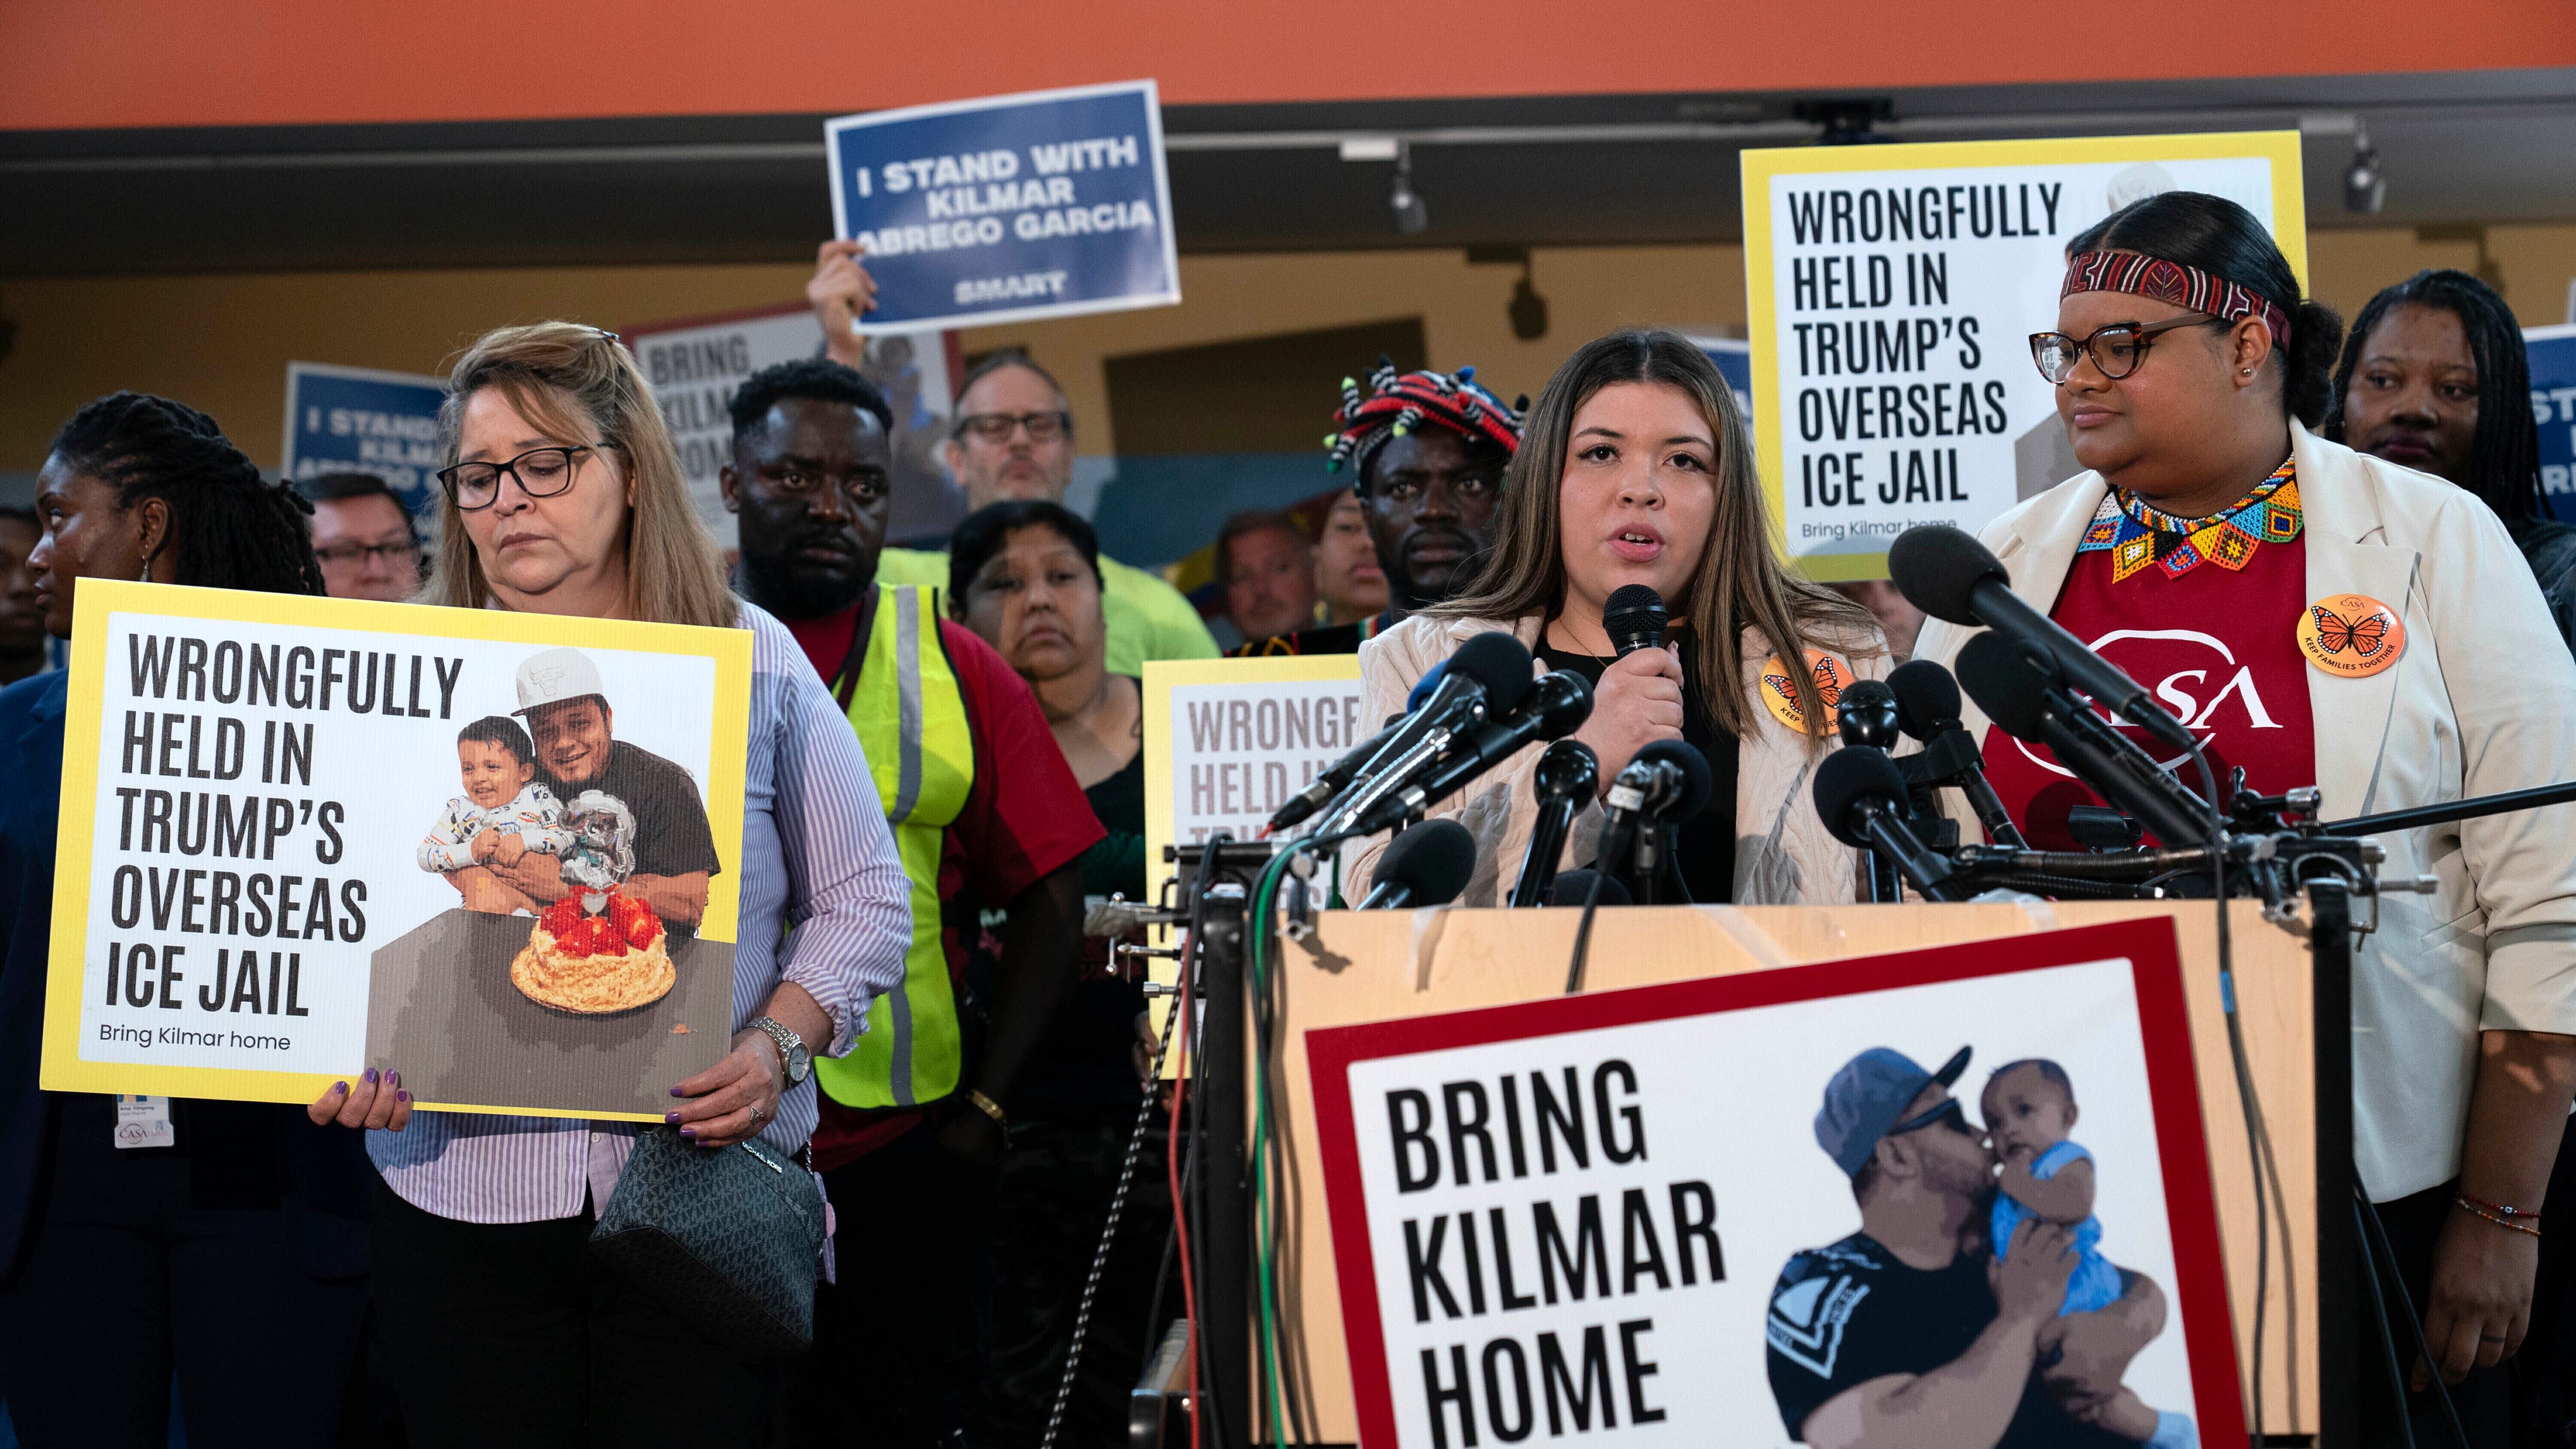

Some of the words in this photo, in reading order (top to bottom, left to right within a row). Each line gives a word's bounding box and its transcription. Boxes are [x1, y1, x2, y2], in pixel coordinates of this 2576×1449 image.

[857, 167, 871, 197] I
[883, 149, 1019, 194] STAND
[1030, 135, 1138, 175] WITH
[927, 177, 1075, 218] KILMAR
[1789, 182, 2061, 245] WRONGFULLY
[855, 216, 1003, 257] ABREGO
[1015, 201, 1155, 241] GARCIA
[955, 270, 1067, 304] SMART
[1793, 254, 1892, 311] HELD
[1907, 252, 1947, 305] IN
[649, 333, 750, 385] BRING
[1793, 316, 1981, 376] TRUMP'S
[1799, 381, 2007, 441] OVERSEAS
[1802, 452, 1865, 507] ICE
[1878, 449, 1968, 504] JAIL
[1802, 522, 1844, 540] Bring
[1850, 520, 1902, 535] Kilmar
[2341, 599, 2364, 609] CASA
[129, 633, 463, 720] WRONGFULLY
[2305, 637, 2319, 654] KEEP
[2317, 653, 2356, 670] FAMILIES
[2359, 644, 2396, 670] TOGETHER
[1188, 696, 1360, 752] WRONGF
[1780, 707, 1800, 722] KEEP
[122, 710, 244, 780] HELD
[262, 721, 314, 786] IN
[1191, 762, 1287, 815] HELD
[116, 788, 344, 864] TRUMP'S
[111, 865, 367, 943] OVERSEAS
[106, 942, 185, 1010] ICE
[199, 949, 308, 1016] JAIL
[99, 1024, 152, 1048] Bring
[159, 1027, 224, 1047] Kilmar
[230, 1031, 291, 1051] home
[120, 1129, 148, 1139] CASA
[1385, 1059, 1648, 1195] BRING
[742, 1141, 767, 1163] MICHAEL
[767, 1159, 783, 1173] KORS
[1403, 1180, 1726, 1323] KILMAR
[1420, 1318, 1667, 1449] HOME
